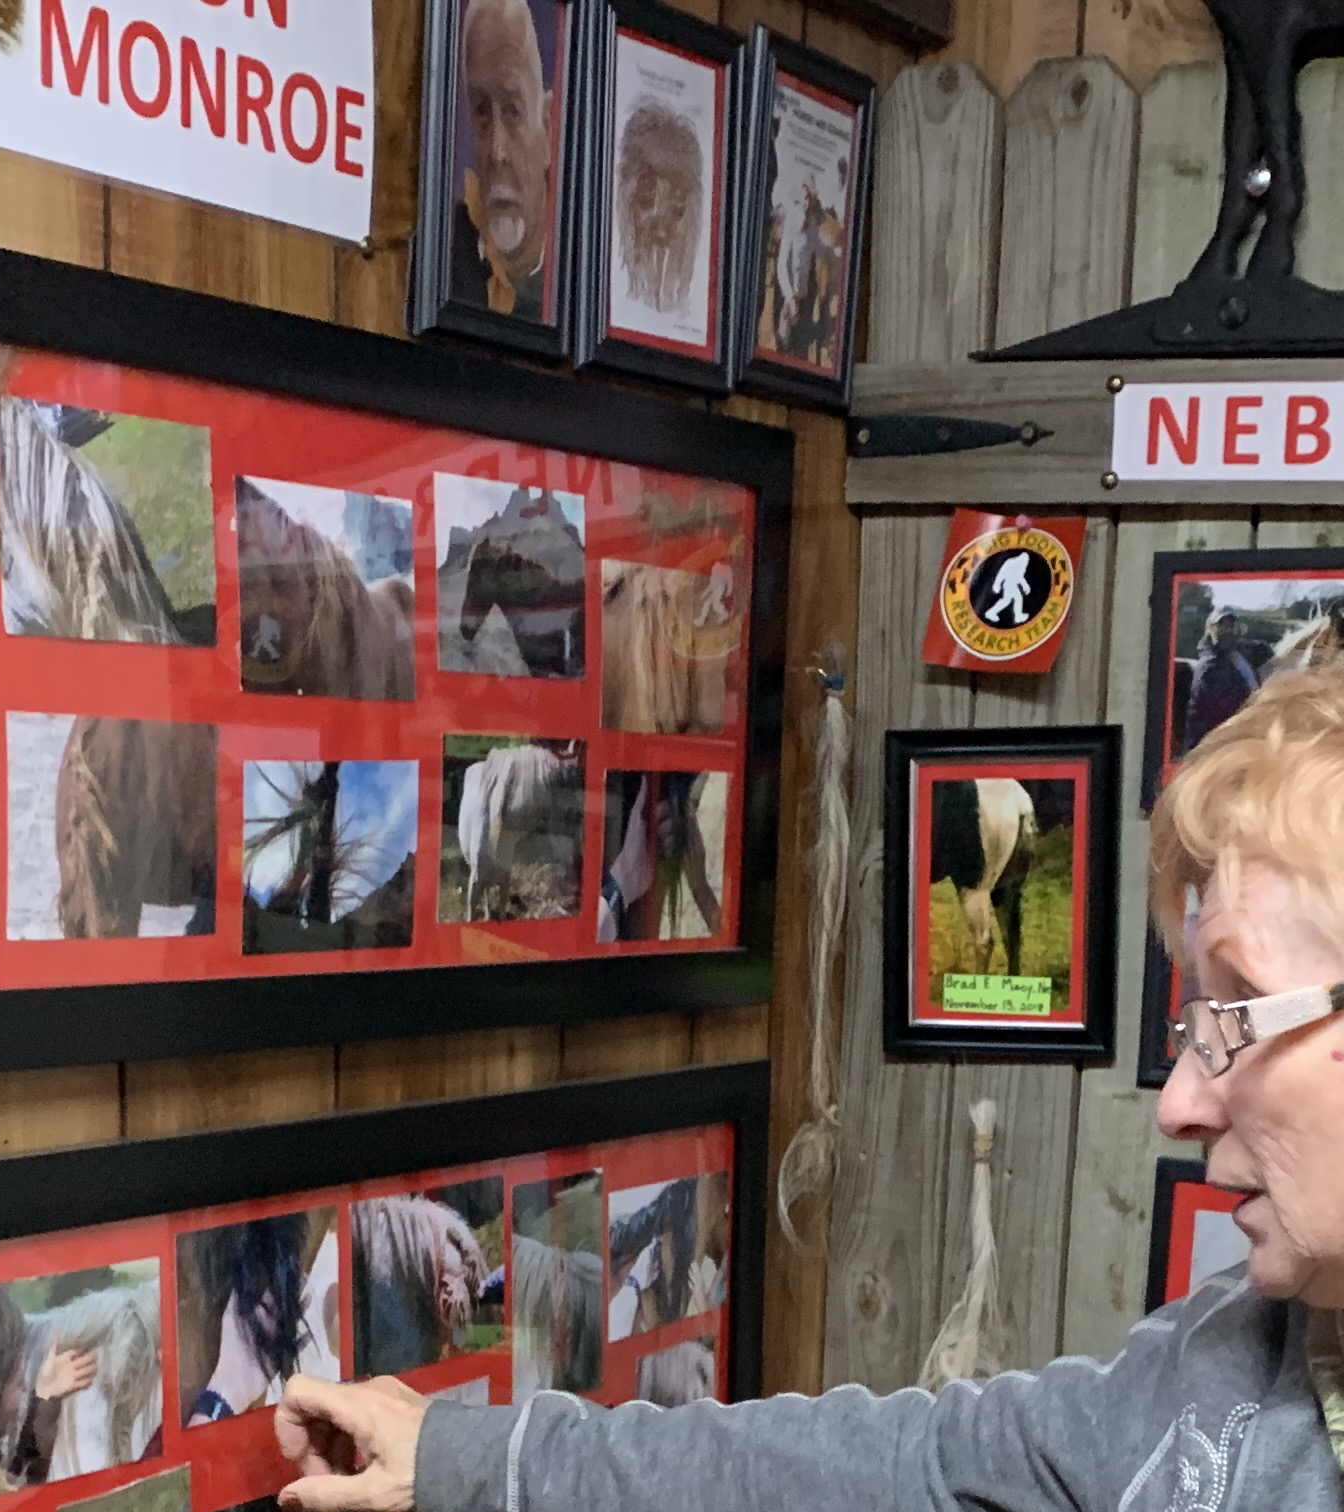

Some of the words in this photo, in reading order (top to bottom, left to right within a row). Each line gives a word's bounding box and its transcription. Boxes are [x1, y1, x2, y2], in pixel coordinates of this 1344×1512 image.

[40, 0, 365, 178] MONROE
[952, 600, 1020, 652] RESEARCH
[1025, 601, 1062, 641] TEAM
[944, 975, 977, 990] Brad
[945, 997, 998, 1012] November
